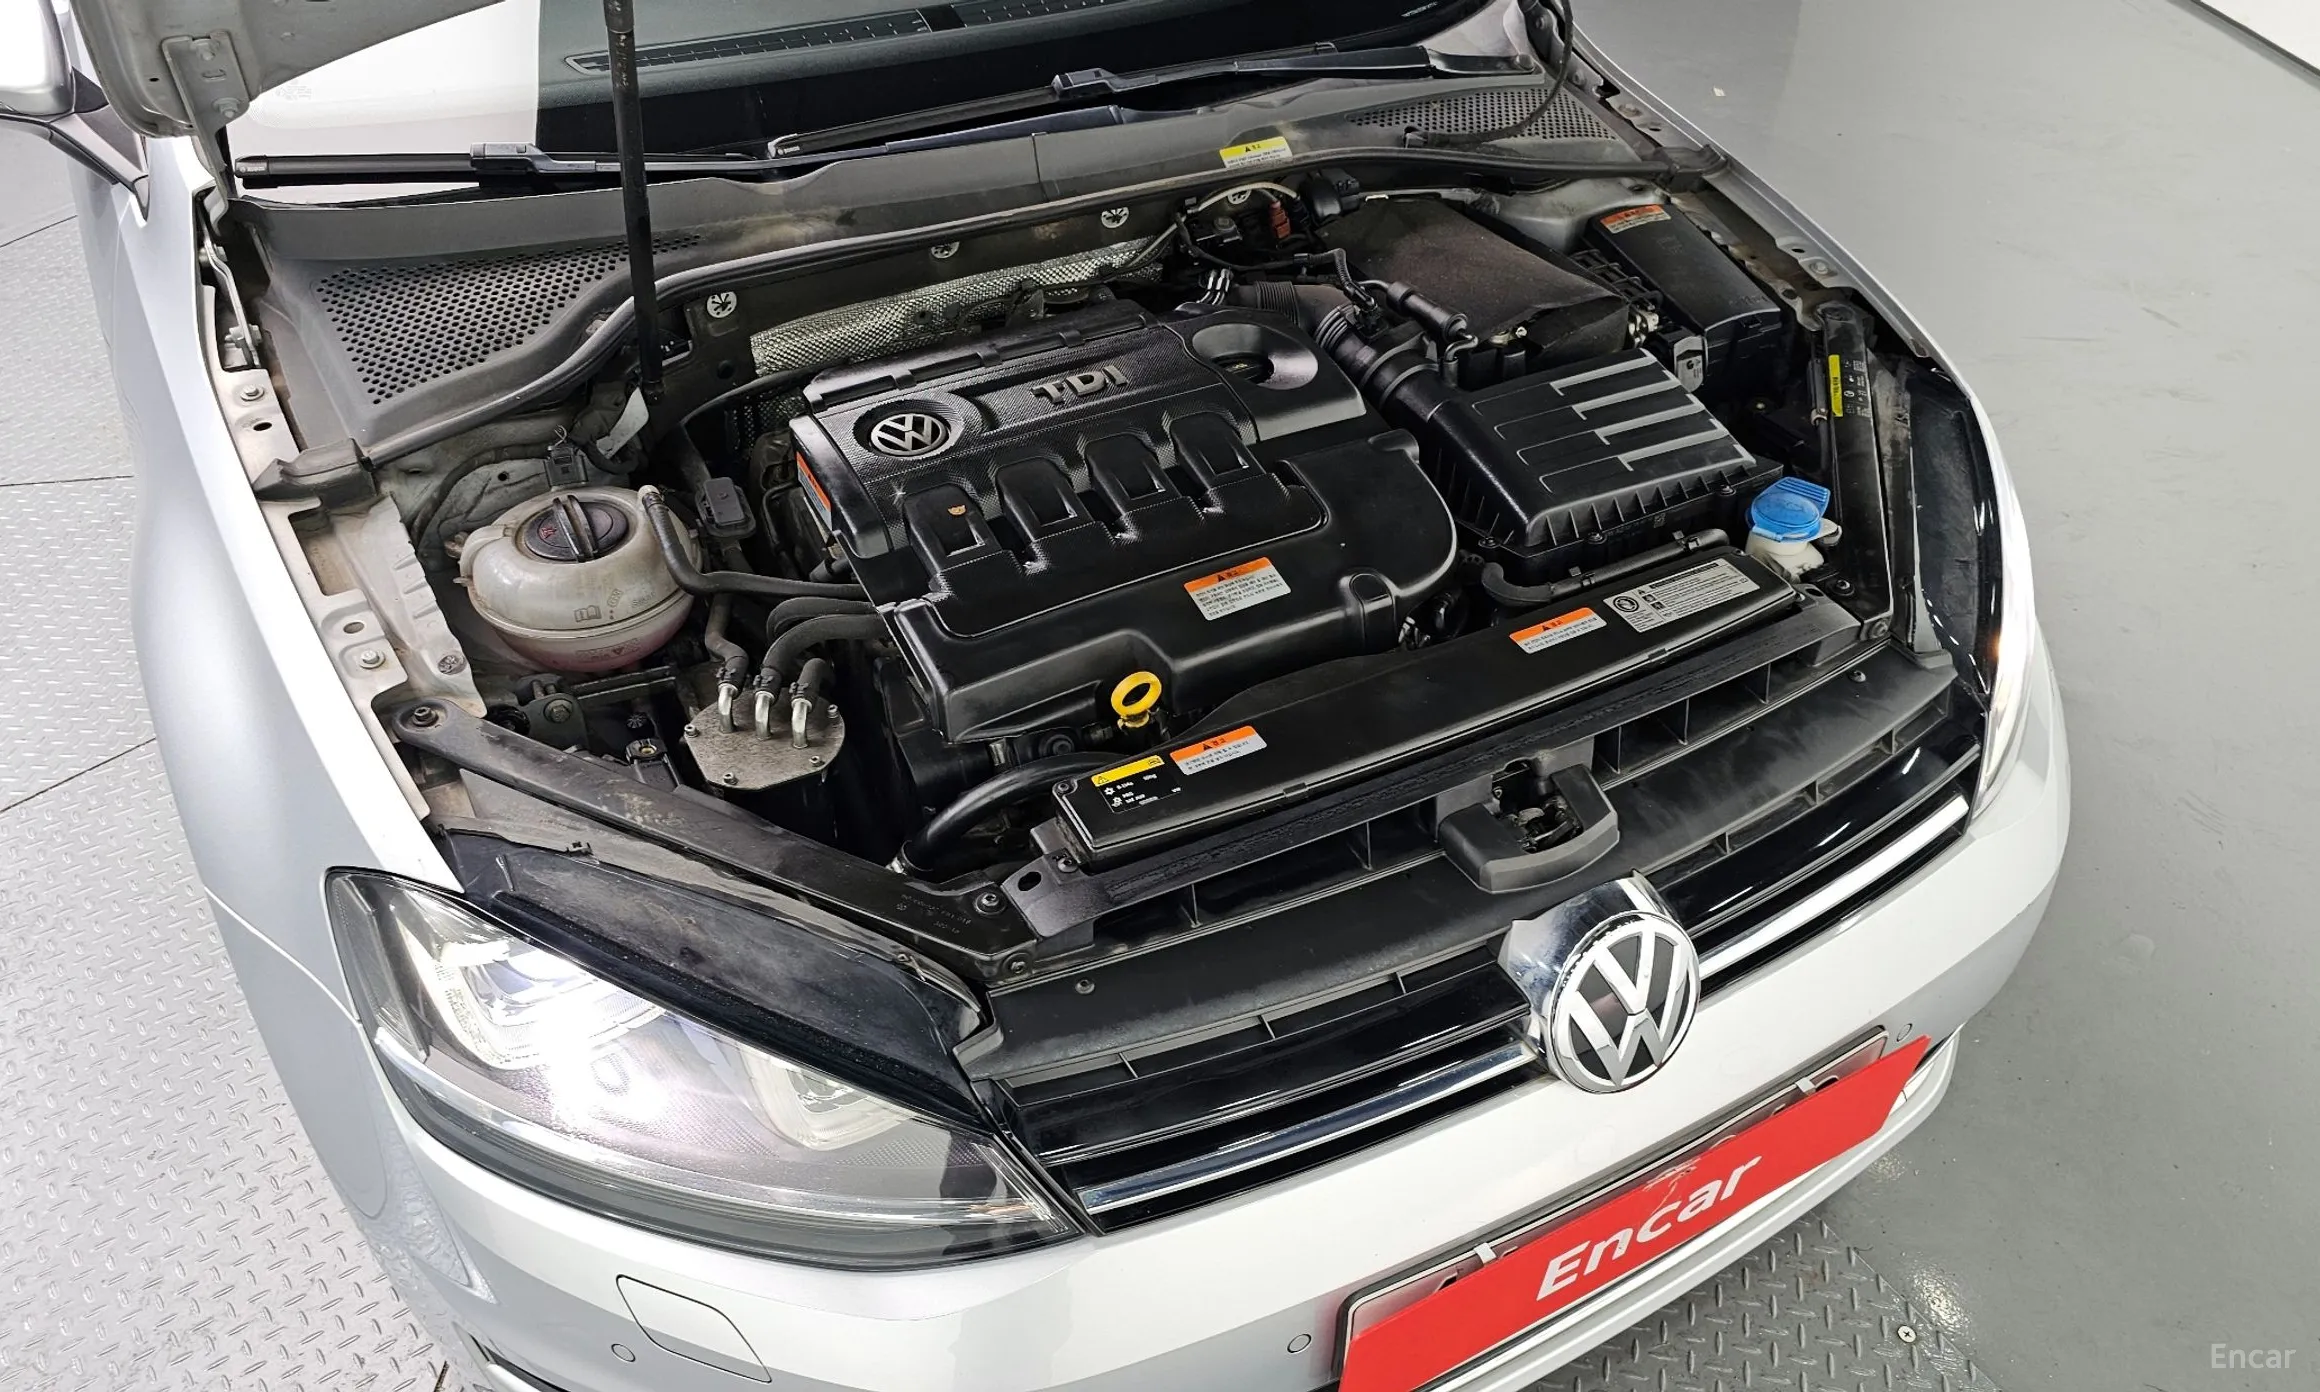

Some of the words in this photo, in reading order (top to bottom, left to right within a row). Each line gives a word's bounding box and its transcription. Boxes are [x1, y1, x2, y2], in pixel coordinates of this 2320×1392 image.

[1030, 365, 1129, 404] TDI
[1550, 910, 1701, 1094] VW
[1536, 1155, 1763, 1302] Encar
